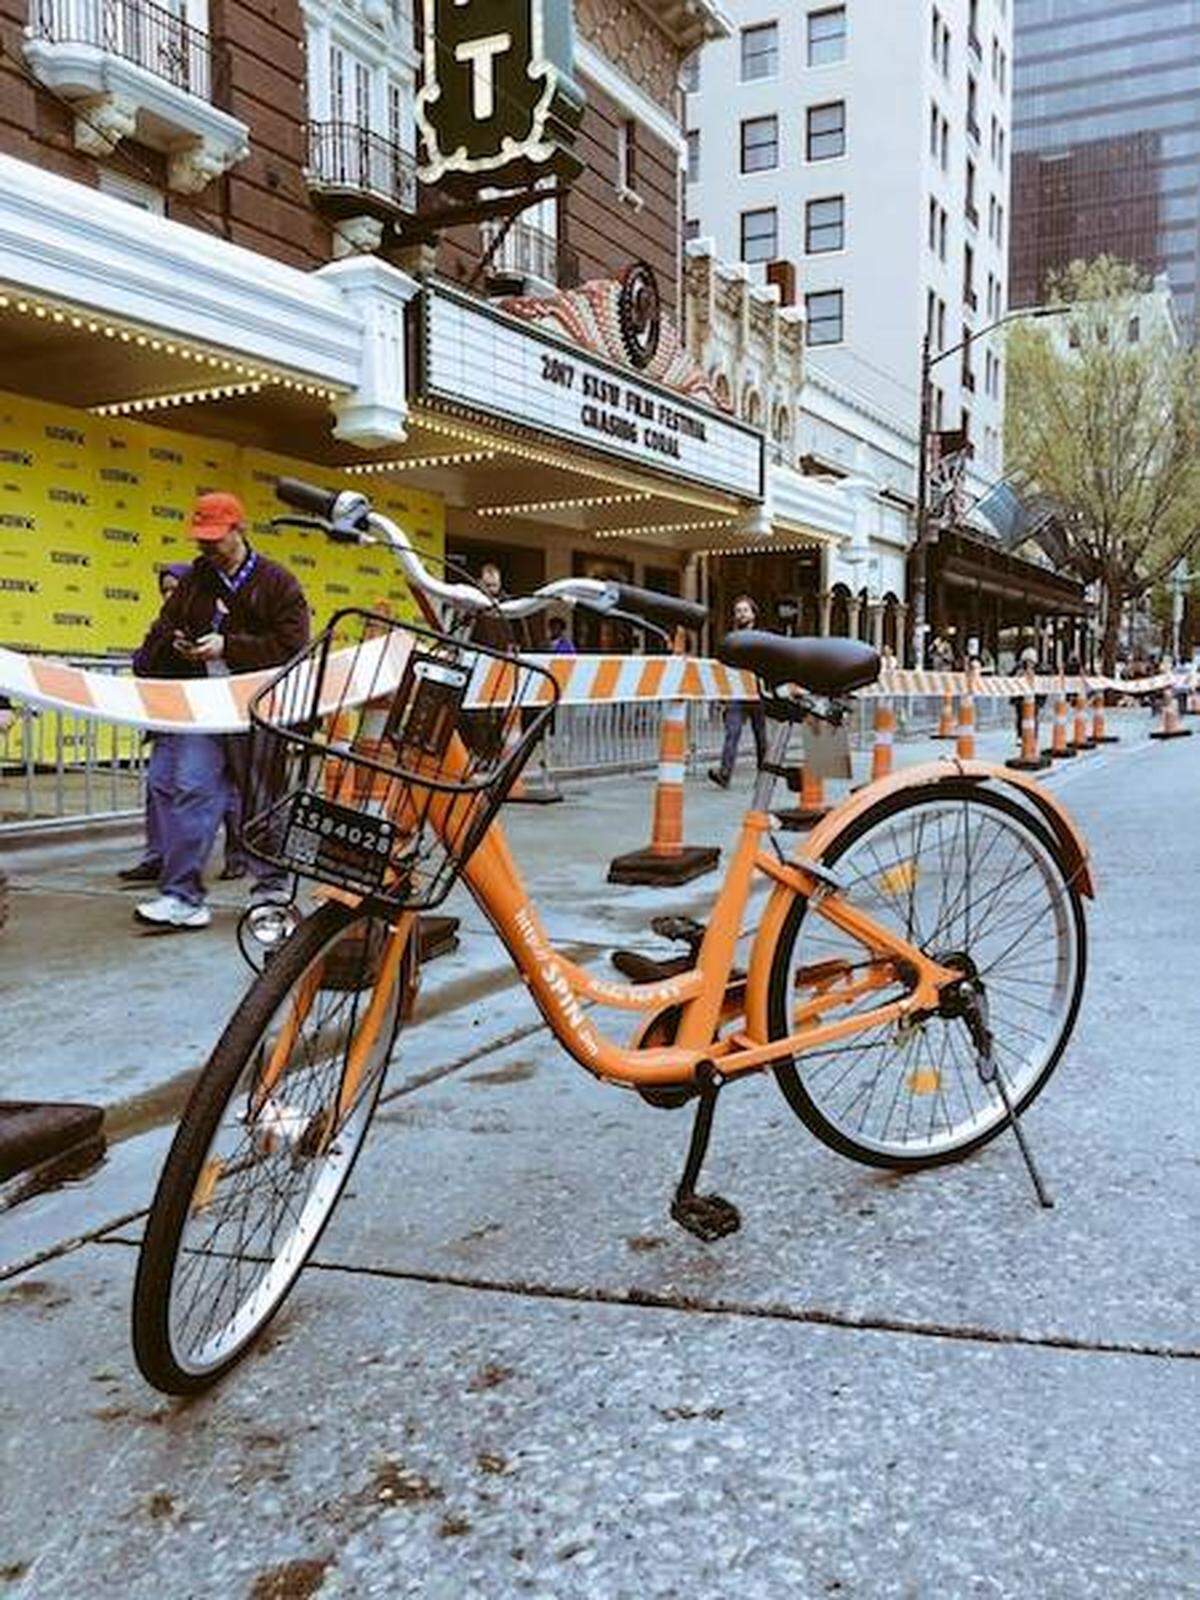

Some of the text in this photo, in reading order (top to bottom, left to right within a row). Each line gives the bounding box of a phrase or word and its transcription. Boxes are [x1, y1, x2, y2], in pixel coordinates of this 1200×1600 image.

[455, 32, 511, 120] T
[541, 354, 574, 389] 2017
[583, 373, 620, 406] SXSW
[625, 389, 655, 420] FILM
